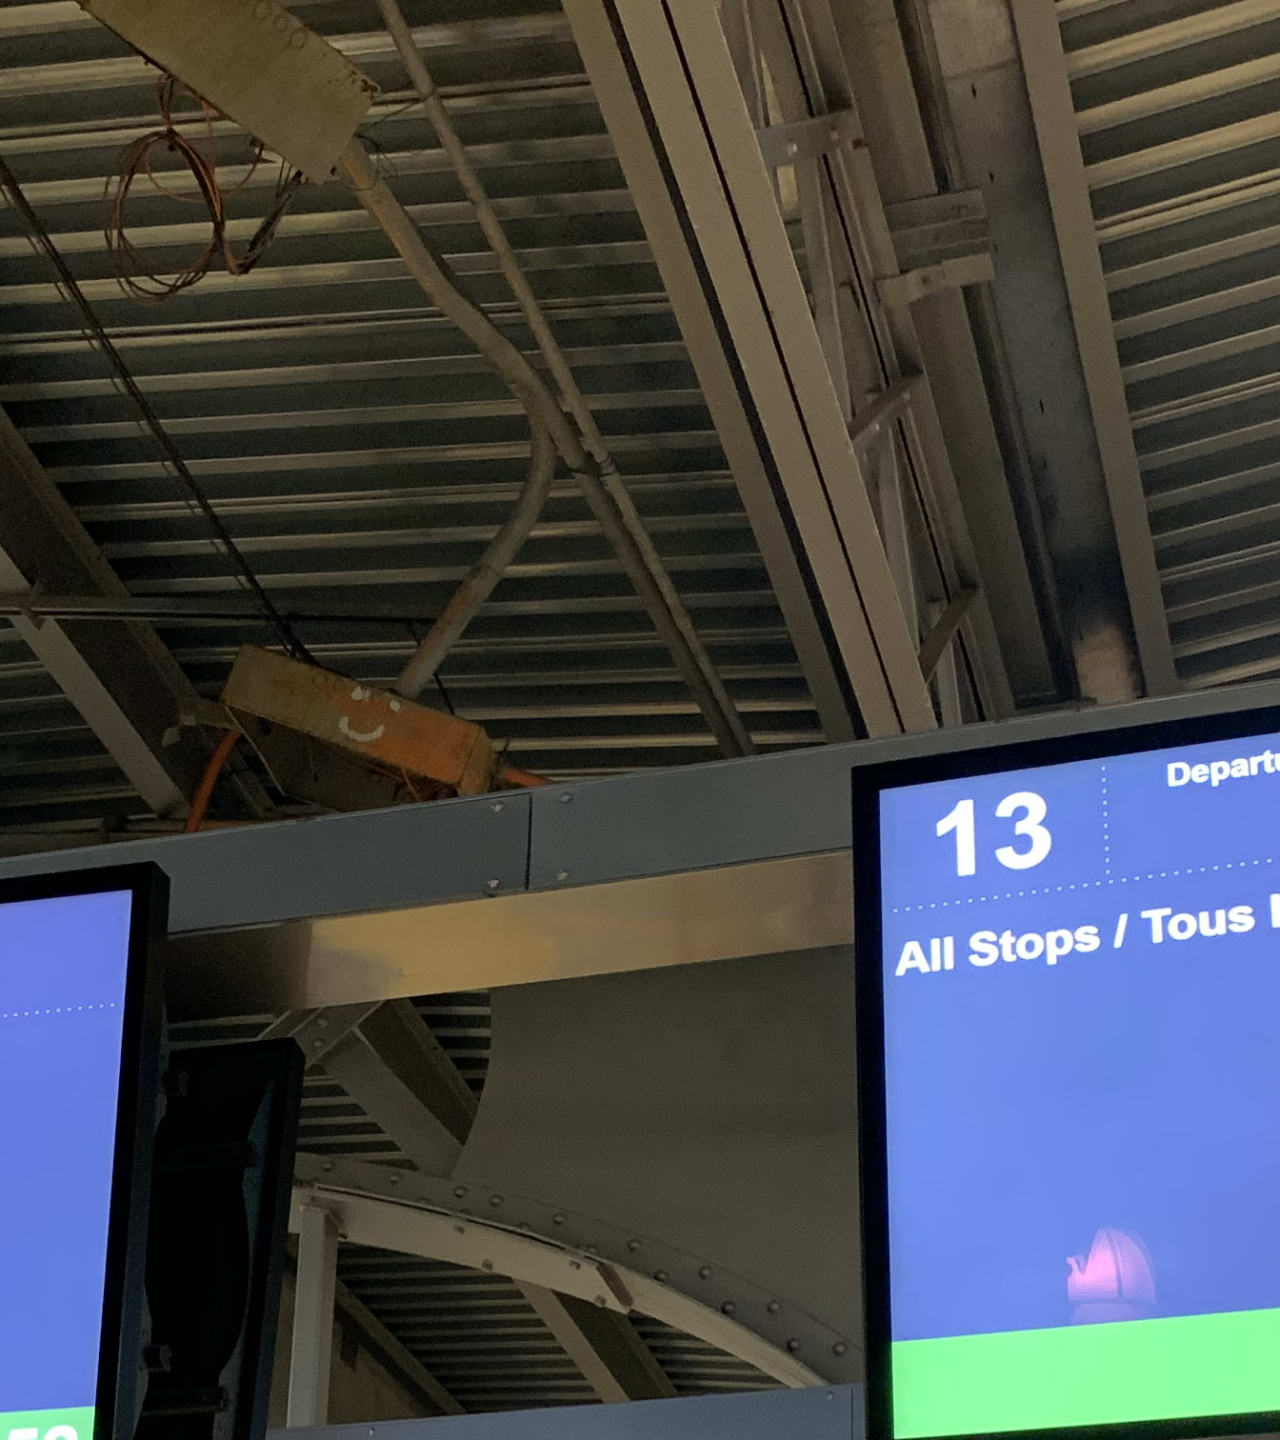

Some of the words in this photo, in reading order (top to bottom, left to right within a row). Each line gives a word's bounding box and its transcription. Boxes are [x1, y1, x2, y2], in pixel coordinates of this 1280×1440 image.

[935, 791, 1052, 877] 13
[895, 936, 955, 976] All
[968, 922, 1100, 965] Stops
[1113, 913, 1128, 949] /
[1141, 906, 1255, 944] Tous
